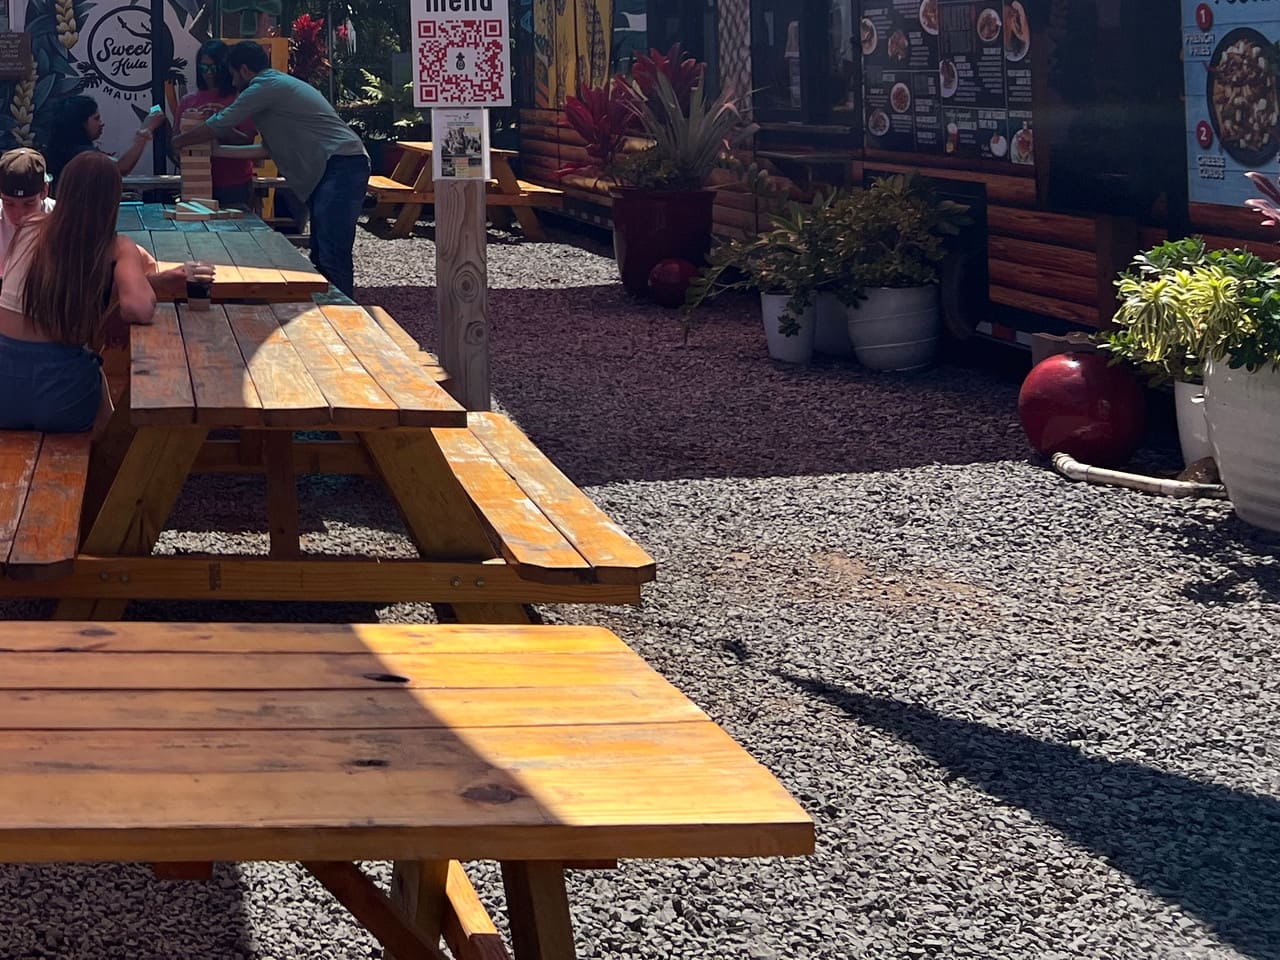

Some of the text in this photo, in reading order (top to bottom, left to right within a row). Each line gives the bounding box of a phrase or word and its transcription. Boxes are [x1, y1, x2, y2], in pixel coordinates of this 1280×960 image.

[96, 37, 152, 62] Sweet
[110, 57, 149, 76] Hula
[102, 86, 138, 101] MAUI
